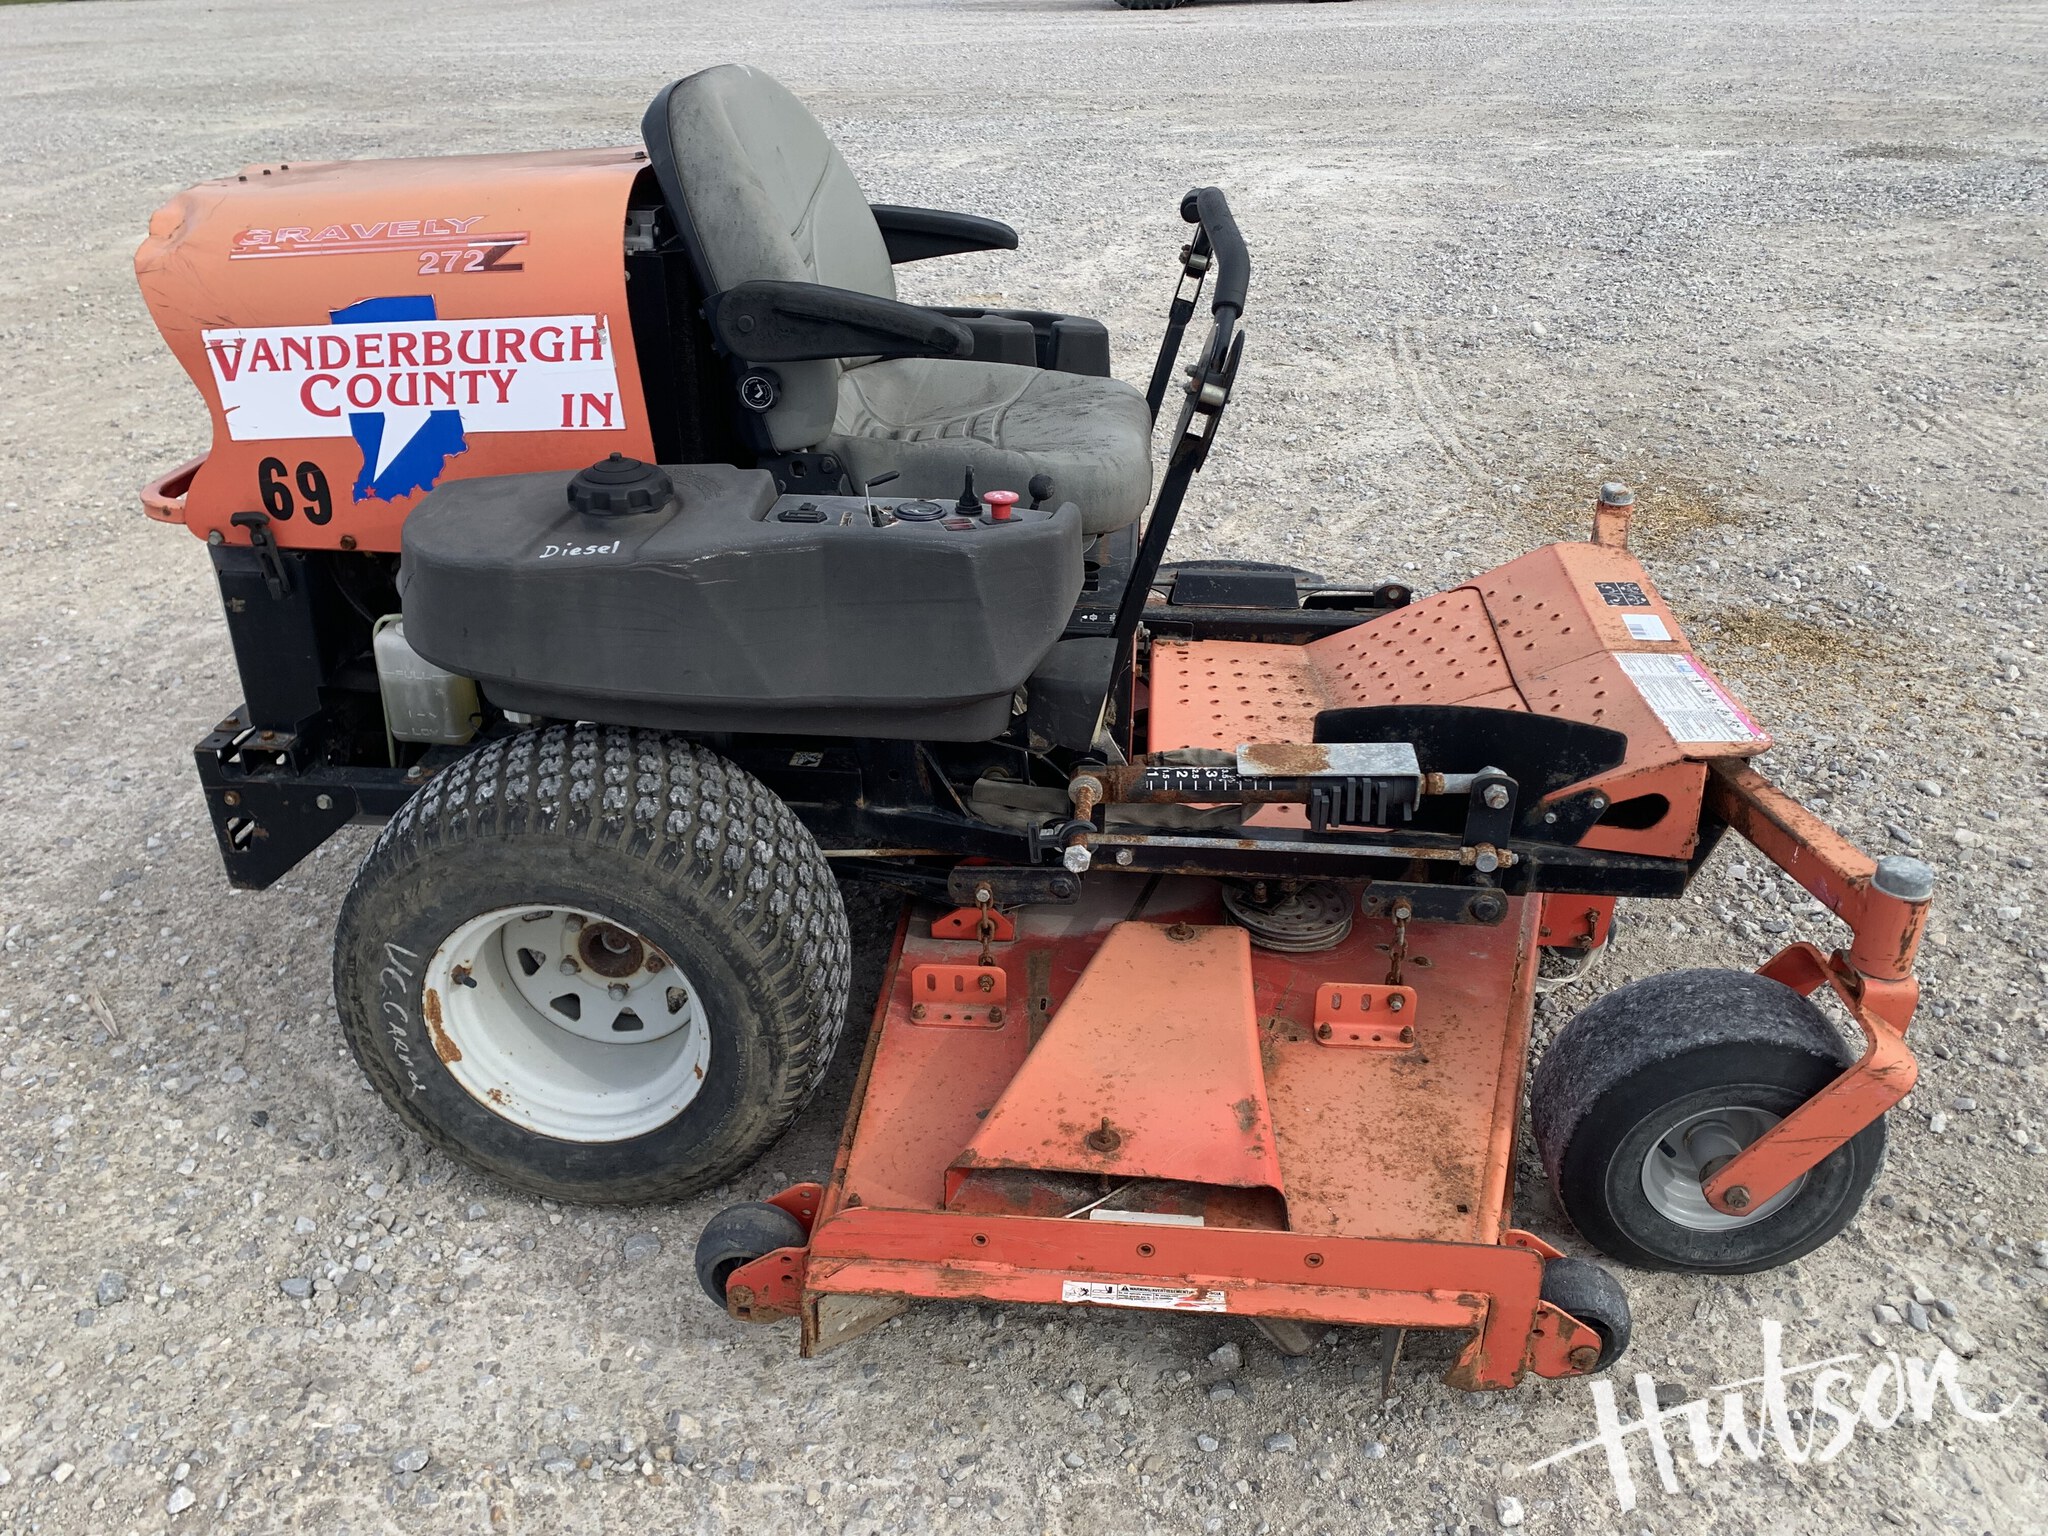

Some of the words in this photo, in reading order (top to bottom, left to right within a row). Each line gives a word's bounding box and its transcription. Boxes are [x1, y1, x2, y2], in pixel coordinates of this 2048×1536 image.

[236, 215, 486, 246] GRAVELY
[206, 325, 604, 382] VANDERBURGH
[299, 368, 518, 418] COUNTY
[560, 392, 614, 428] IN
[257, 456, 333, 526] 69
[538, 540, 621, 559] Diesel
[395, 669, 433, 680] FULL
[1176, 770, 1189, 778] 2
[1205, 770, 1218, 778] 3
